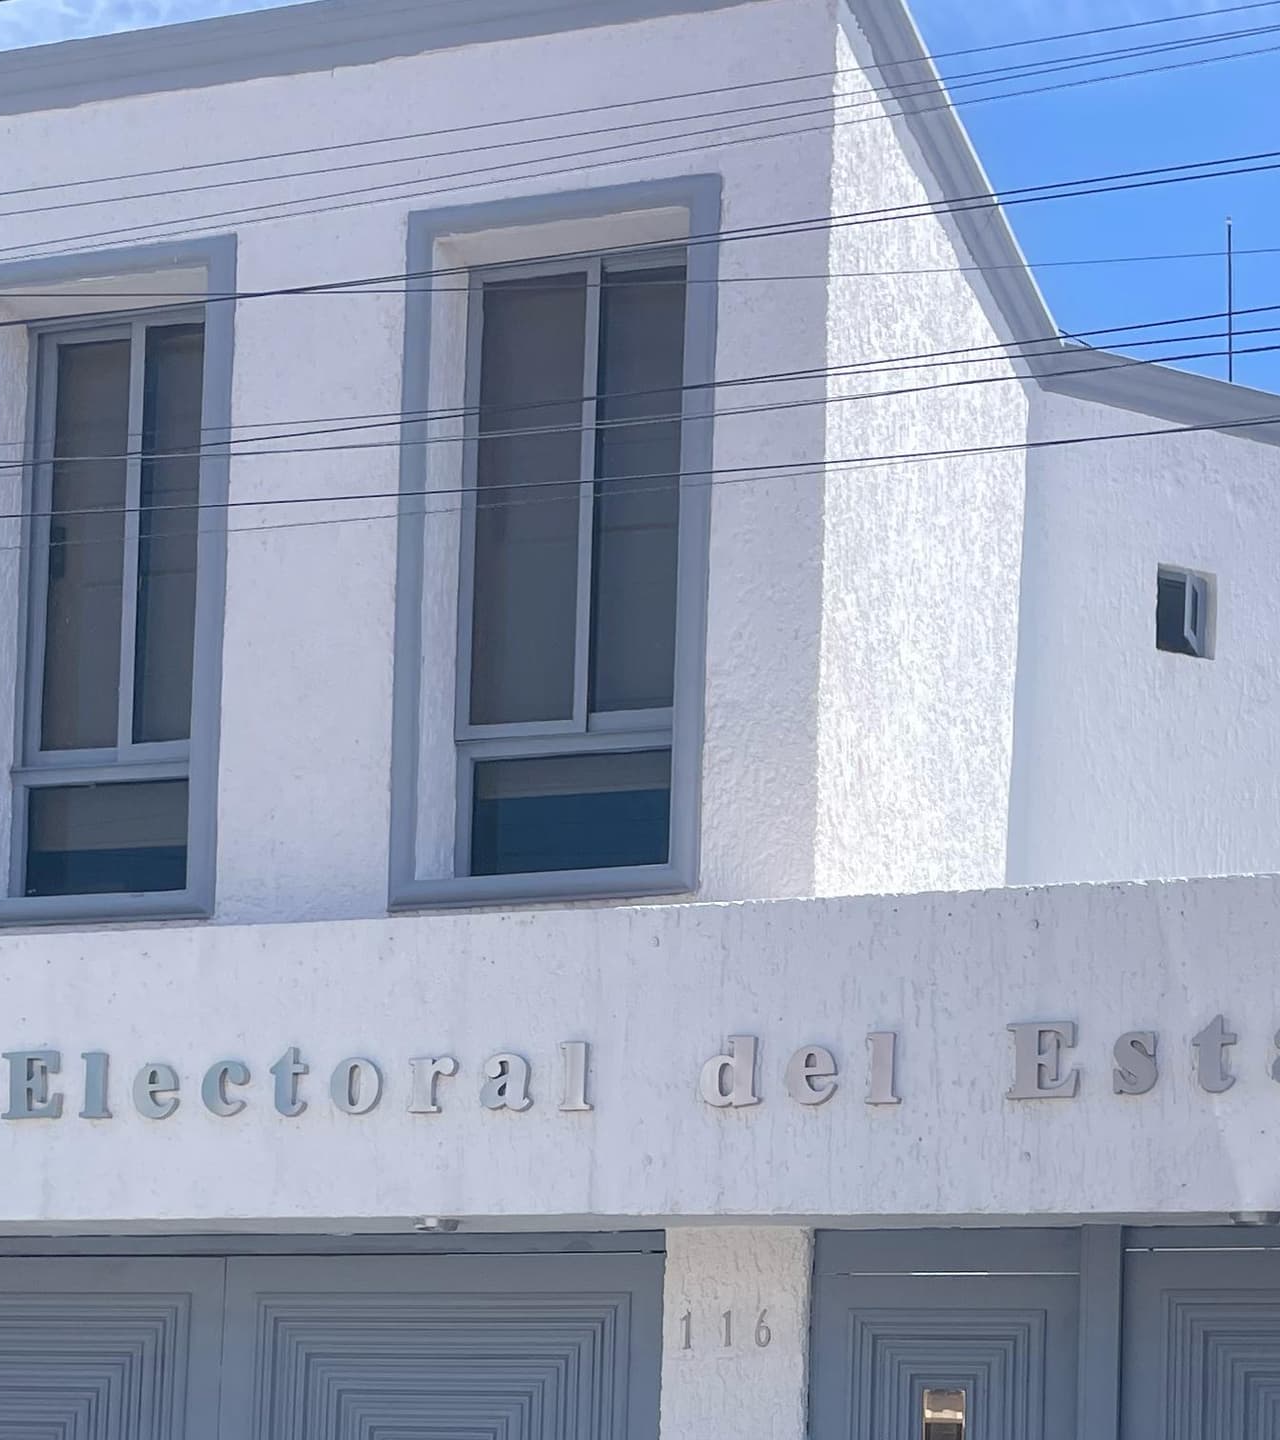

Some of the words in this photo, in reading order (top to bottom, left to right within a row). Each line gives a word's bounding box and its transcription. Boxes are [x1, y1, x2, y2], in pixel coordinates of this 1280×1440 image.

[0, 1040, 594, 1120] Electoral
[699, 1031, 902, 1110] del
[680, 1308, 772, 1350] 116
